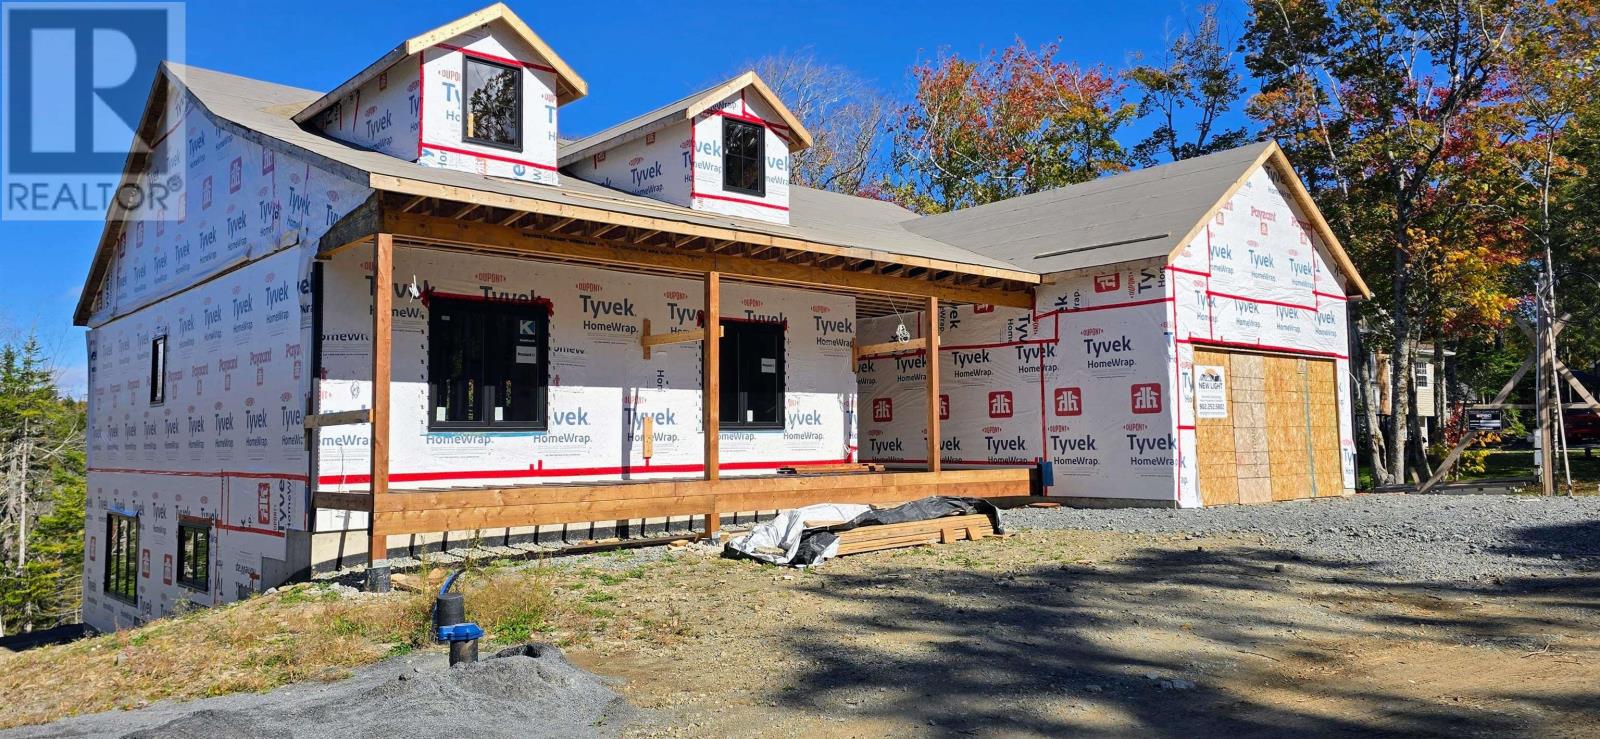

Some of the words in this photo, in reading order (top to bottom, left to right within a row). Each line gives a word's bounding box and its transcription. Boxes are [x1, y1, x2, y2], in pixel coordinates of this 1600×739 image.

[366, 108, 392, 140] Tyvek
[631, 161, 662, 187] Tyvek
[227, 210, 247, 239] Tyvek
[1248, 249, 1275, 269] Tyvek
[1289, 258, 1313, 277] Tyvek
[233, 292, 253, 320] Tyvek
[265, 280, 289, 310] Tyvek
[204, 304, 222, 330] Tyvek
[579, 294, 634, 319] Tyvek
[813, 315, 853, 335] Tyvek
[1084, 335, 1132, 358] Tyvek
[951, 349, 990, 369] Tyvek
[1018, 365, 1057, 375] Homerap
[165, 417, 179, 439] Tyvek
[188, 415, 204, 437] Tyvek
[215, 412, 234, 436] Tyvek
[246, 408, 267, 434] Tyvek
[281, 406, 302, 431] Tyve
[870, 437, 903, 454] Tyvek
[985, 435, 1025, 455] Tyvek
[1050, 435, 1096, 454] Tyvek
[1127, 434, 1177, 454] Tyvek
